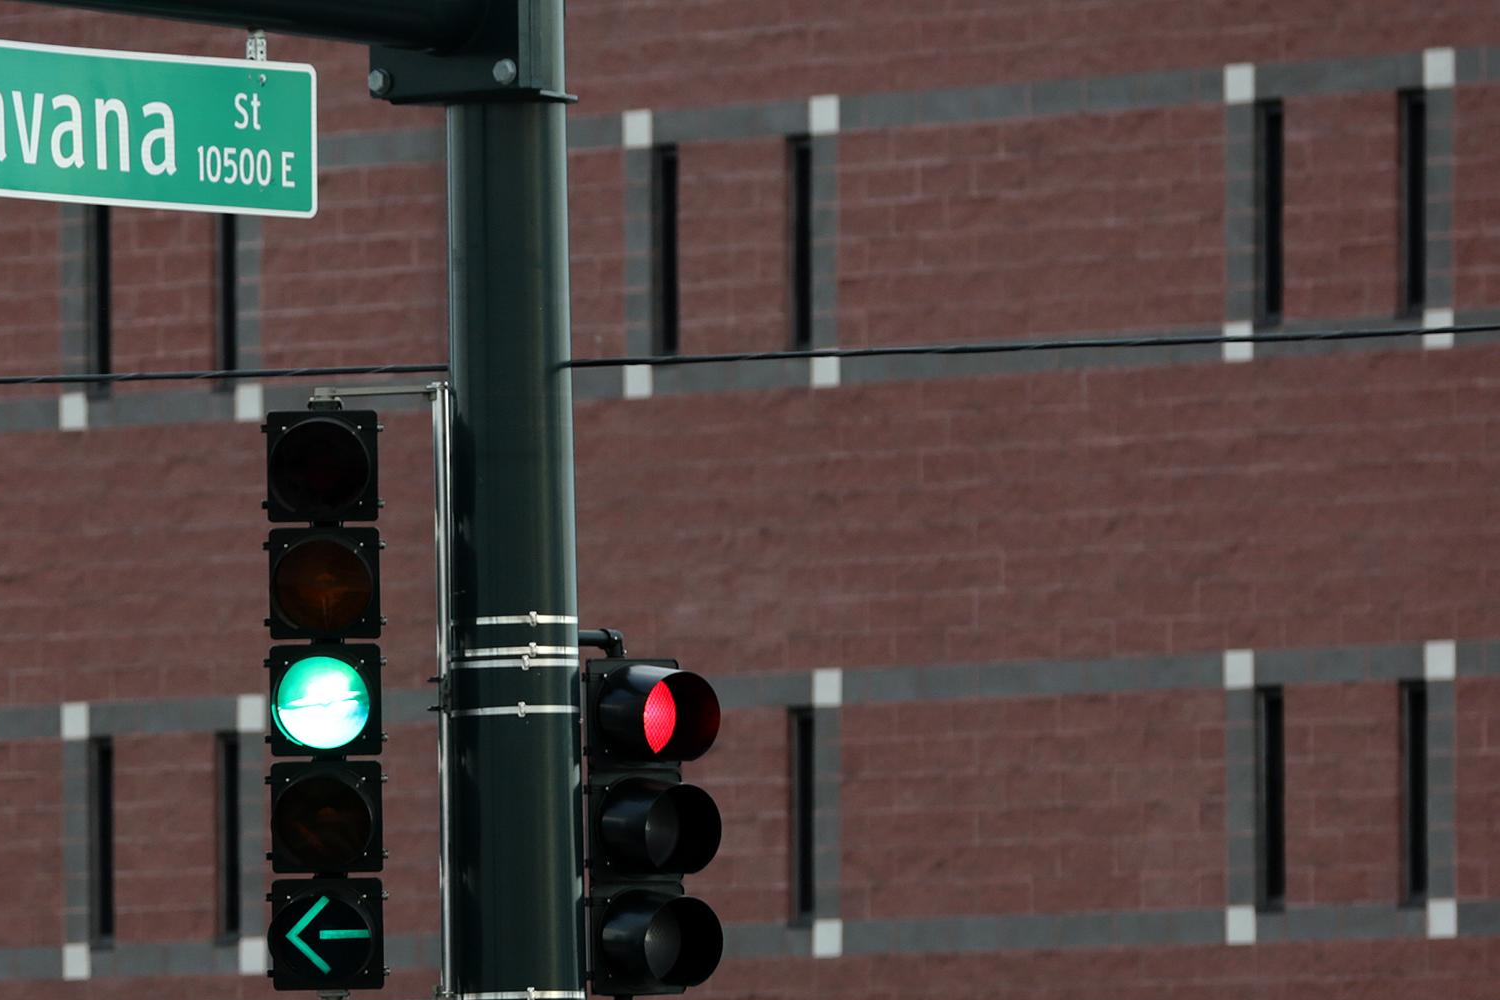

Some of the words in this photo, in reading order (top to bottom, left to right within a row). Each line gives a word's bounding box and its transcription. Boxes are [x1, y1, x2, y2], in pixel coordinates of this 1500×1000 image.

[234, 92, 261, 131] St
[198, 145, 272, 186] 10500
[281, 151, 296, 188] E
